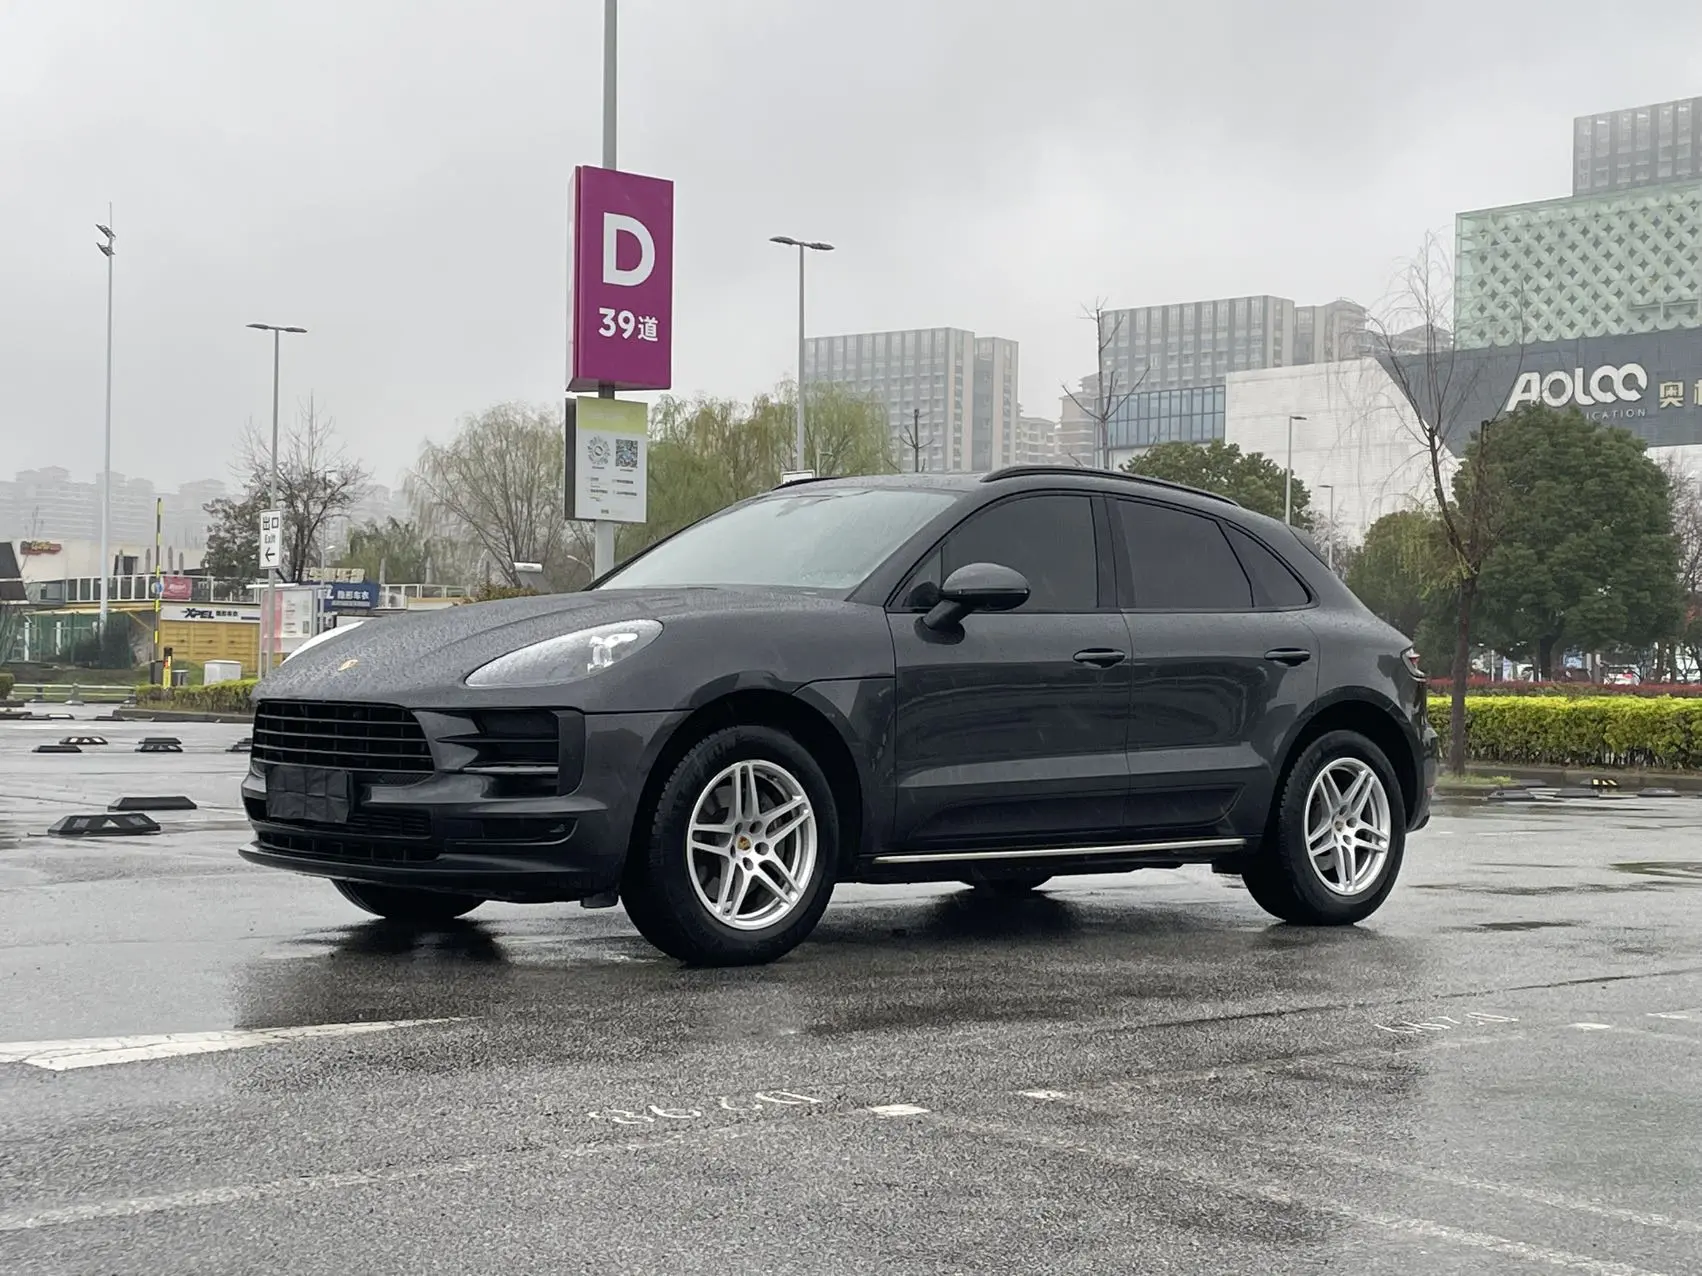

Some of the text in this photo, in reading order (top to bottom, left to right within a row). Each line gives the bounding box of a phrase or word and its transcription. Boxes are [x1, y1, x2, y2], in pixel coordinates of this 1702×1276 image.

[603, 211, 656, 287] D
[599, 307, 658, 342] 39道
[262, 515, 279, 531] 出口
